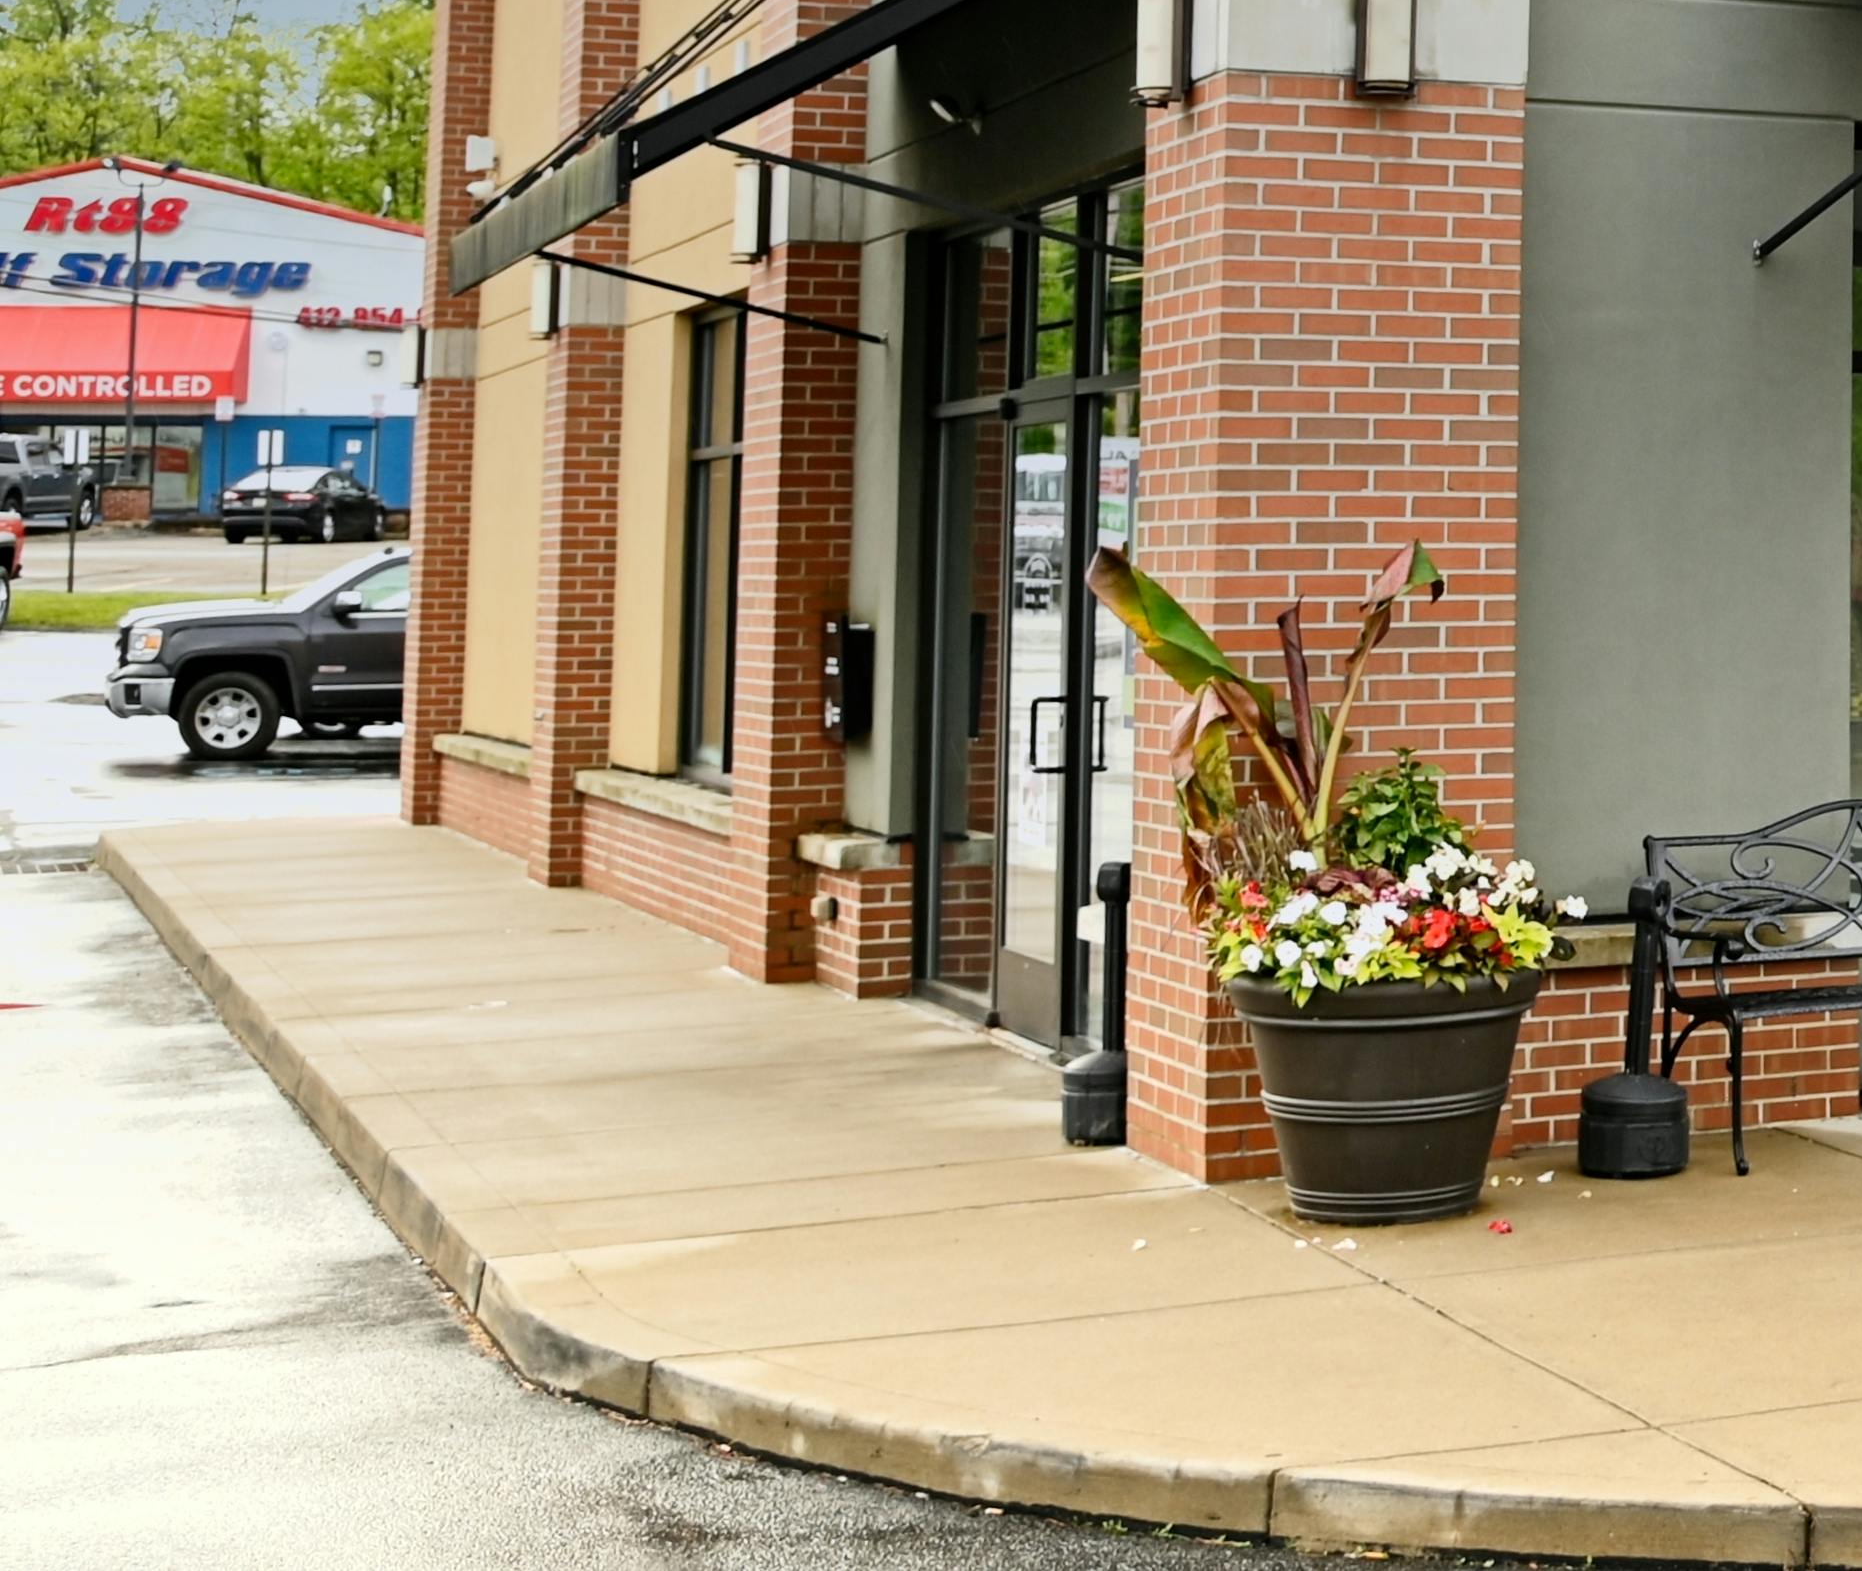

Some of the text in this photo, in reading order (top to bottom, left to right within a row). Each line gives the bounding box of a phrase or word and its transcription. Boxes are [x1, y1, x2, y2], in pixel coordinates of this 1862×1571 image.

[24, 196, 189, 236] Rt88
[50, 252, 312, 297] Storage
[13, 374, 212, 398] CONTROLLED
